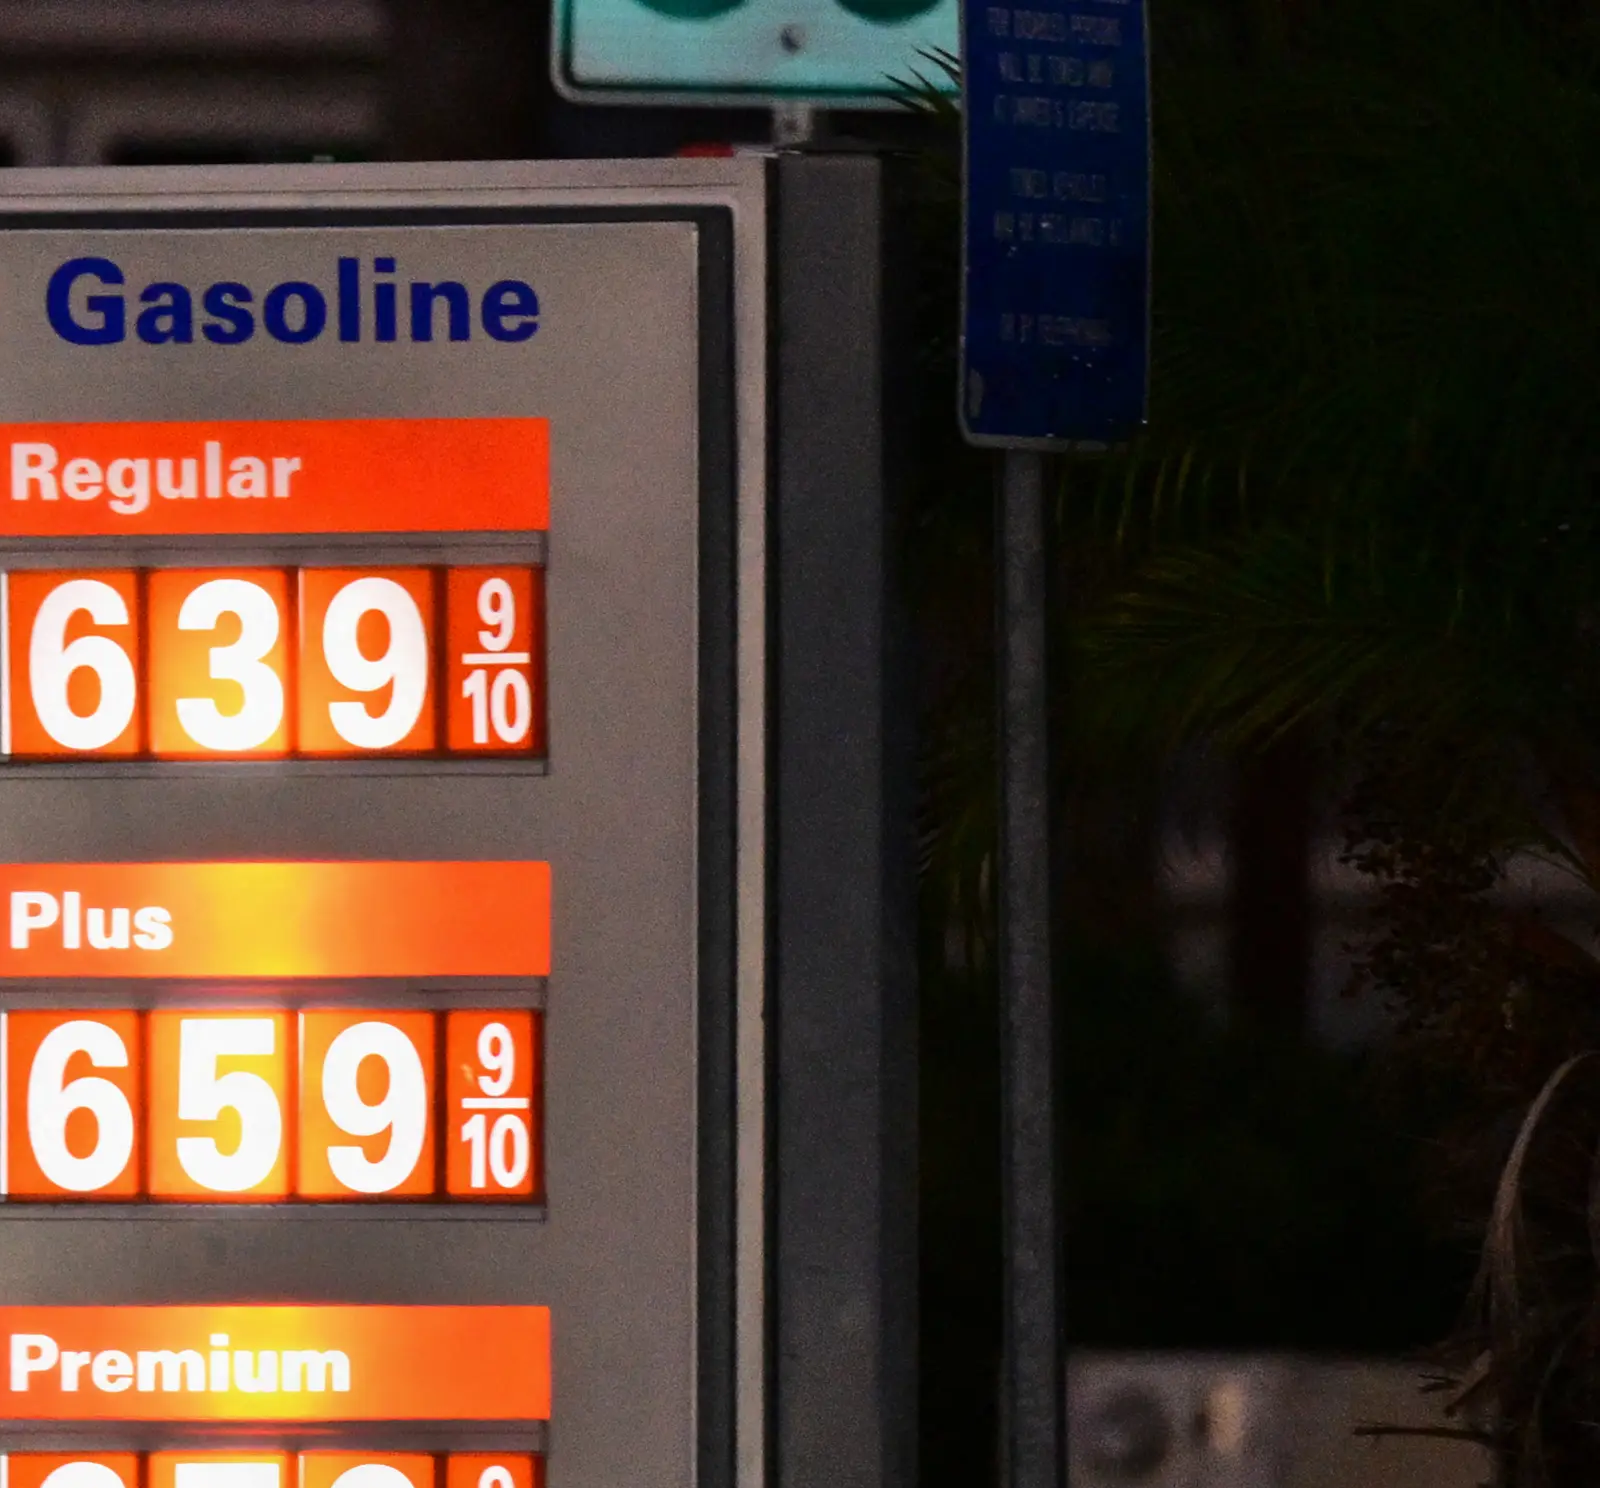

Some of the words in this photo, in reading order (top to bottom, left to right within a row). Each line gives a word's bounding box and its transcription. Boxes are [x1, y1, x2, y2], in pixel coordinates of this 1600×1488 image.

[46, 257, 540, 345] Gasoline
[11, 442, 300, 513] Regular
[476, 577, 516, 652] 9
[29, 578, 428, 751] 639
[462, 668, 532, 744] 10
[10, 891, 173, 950] Plus
[476, 1022, 516, 1096] 9
[27, 1018, 427, 1193] 659
[461, 1114, 530, 1188] 10
[9, 1334, 351, 1392] Premium
